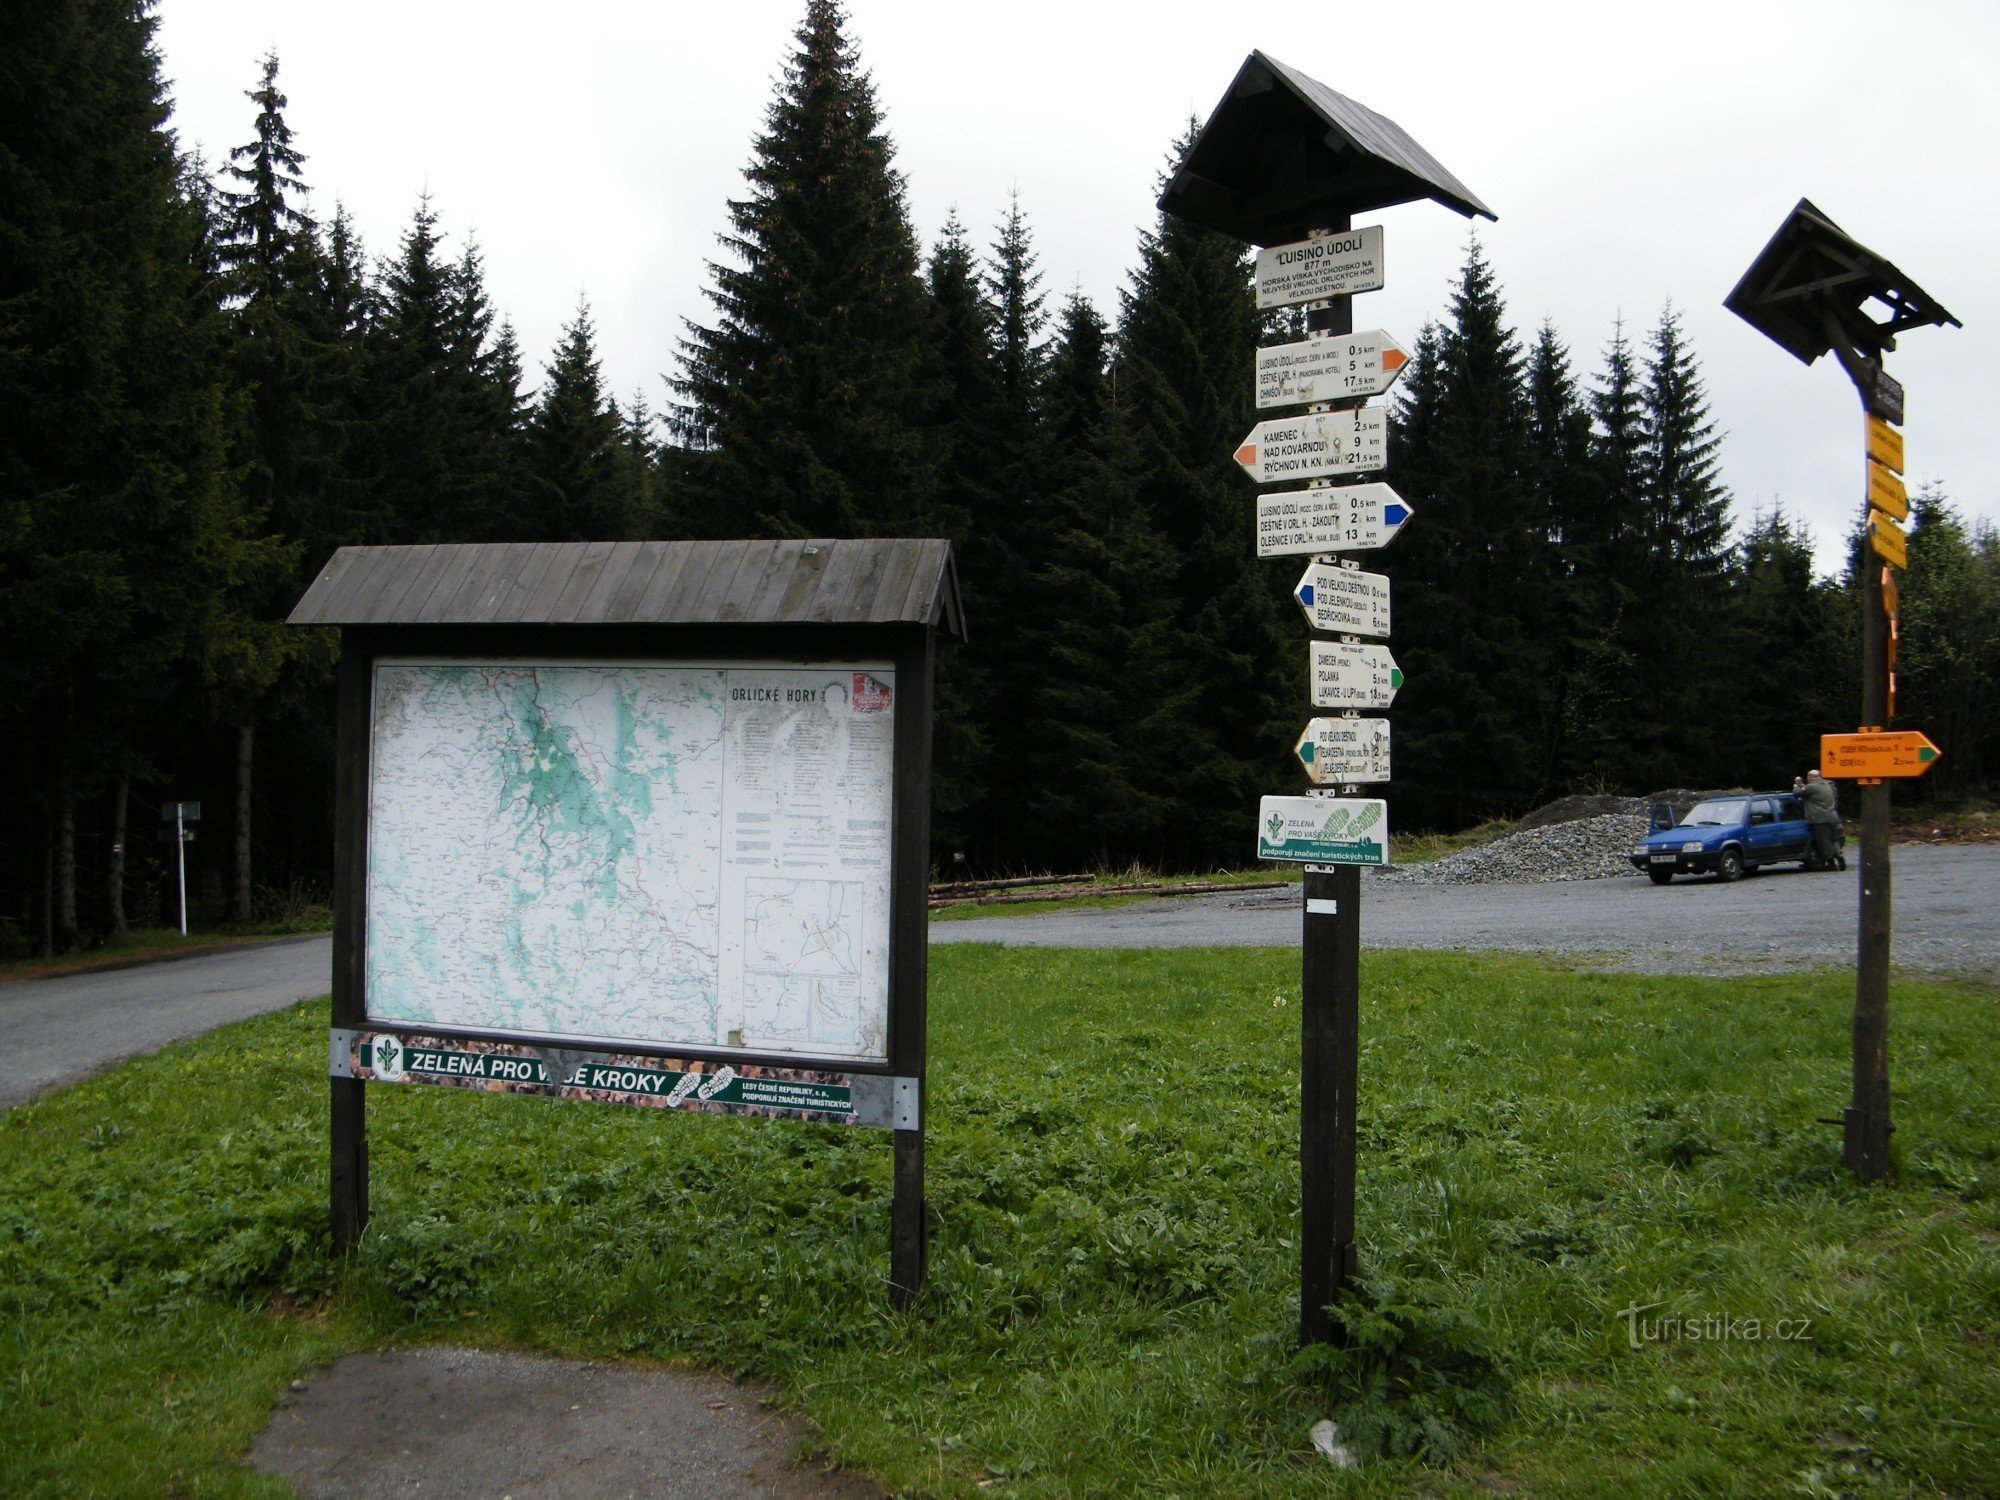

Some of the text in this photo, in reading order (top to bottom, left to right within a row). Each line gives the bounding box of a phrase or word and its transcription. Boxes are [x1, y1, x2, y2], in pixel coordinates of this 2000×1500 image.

[1279, 235, 1362, 265] LUISINO ÚDOLÍ
[1262, 275, 1291, 287] HORSKÁ
[1314, 262, 1360, 277] VÝCHODISKO
[1304, 260, 1320, 271] 877
[1262, 268, 1375, 295] NEJVYŠŠÍ VRCHOL ORLICKÝCH HOR
[1288, 289, 1314, 299] VELKOU
[1260, 358, 1279, 370] LUISINO
[1279, 353, 1293, 366] ÚDOLÍ
[1349, 345, 1363, 356] 0,5
[1363, 346, 1375, 354] km
[1260, 371, 1277, 384] DEŠTNÉ
[1349, 361, 1356, 371] 5
[1260, 386, 1281, 399] OHNIŠOV
[1344, 376, 1362, 387] 17,5
[1264, 429, 1298, 444] KAMENEC
[1354, 421, 1367, 432] 2,5
[1264, 447, 1280, 458] NAD
[1354, 437, 1361, 447] 9
[1370, 438, 1380, 446] km
[1301, 458, 1308, 469] N.
[1310, 457, 1323, 468] KN.
[1348, 452, 1367, 463] 21,5
[1261, 505, 1280, 517] LUISINO
[1282, 501, 1298, 515] ÚDOLÍ
[1351, 498, 1364, 509] 0,5
[1261, 518, 1282, 532] DEŠTNÉ
[1351, 513, 1358, 524] 2
[1366, 515, 1376, 523] km
[1261, 534, 1288, 547] OLEŠNICE
[1289, 534, 1293, 545] V
[1346, 529, 1358, 540] 13
[1317, 577, 1327, 589] POD
[1328, 579, 1347, 592] VELKOU
[1348, 581, 1370, 596] DEŠTNOU
[1381, 591, 1388, 599] km
[1317, 593, 1328, 605] POD
[1328, 595, 1353, 609] JELENKOU
[1372, 602, 1377, 612] 3
[1318, 608, 1351, 623] BEDŘICHOVKA
[1372, 617, 1380, 628] 6,5
[1372, 658, 1377, 668] 3
[1319, 670, 1339, 681] POLANKA
[1372, 674, 1380, 684] 5,5
[787, 689, 816, 702] HORY
[1319, 687, 1340, 698] LUKAVICE
[1374, 746, 1379, 757] 2
[1288, 829, 1349, 840] PRO VAŠE KROKY
[1262, 849, 1293, 858] podporují
[1321, 851, 1363, 861] turistických
[411, 1053, 666, 1092] ZELENÁ PRO VE KROKY
[742, 1082, 757, 1091] LESY
[758, 1082, 778, 1093] ČESKÉ
[742, 1092, 851, 1109] PODPORUJÍ ZNAČENÍ TURISTICKÝCH
